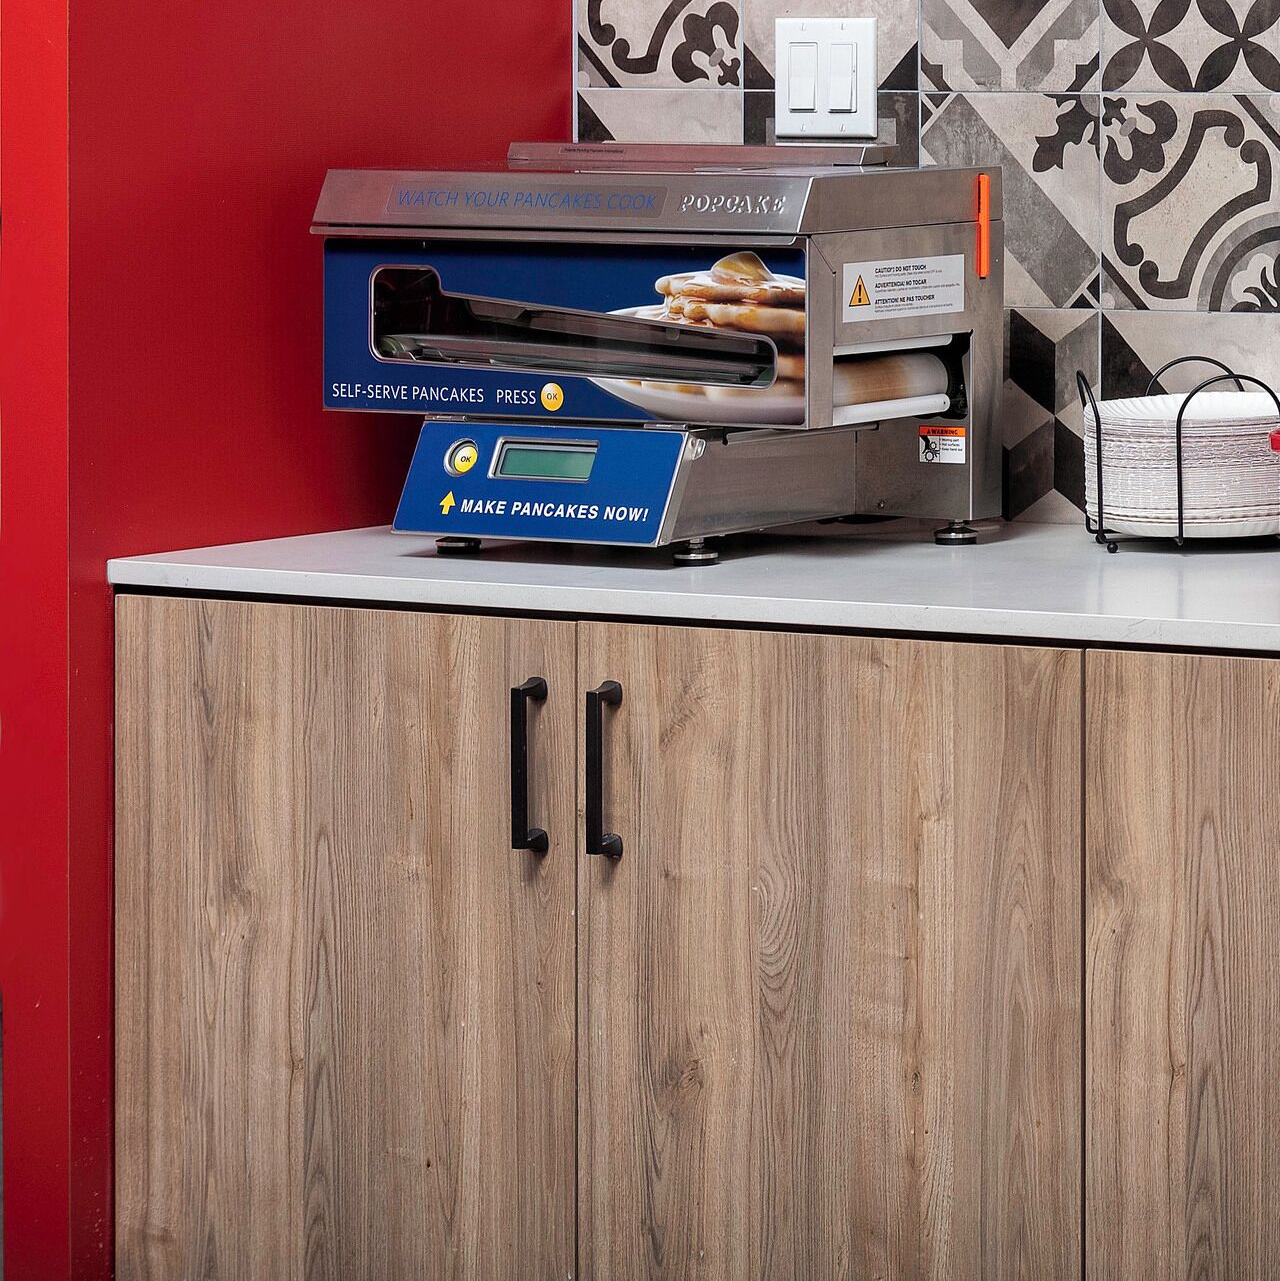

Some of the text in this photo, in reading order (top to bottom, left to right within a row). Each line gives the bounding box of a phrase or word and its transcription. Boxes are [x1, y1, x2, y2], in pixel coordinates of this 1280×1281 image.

[399, 190, 657, 211] WATCH YOUR PANCAKES COOK
[679, 194, 787, 214] POPCAKE
[332, 383, 558, 405] SELF-SERVE PANCAKES PRESS OK
[461, 499, 649, 522] MAKE PANCAKES NOW!
